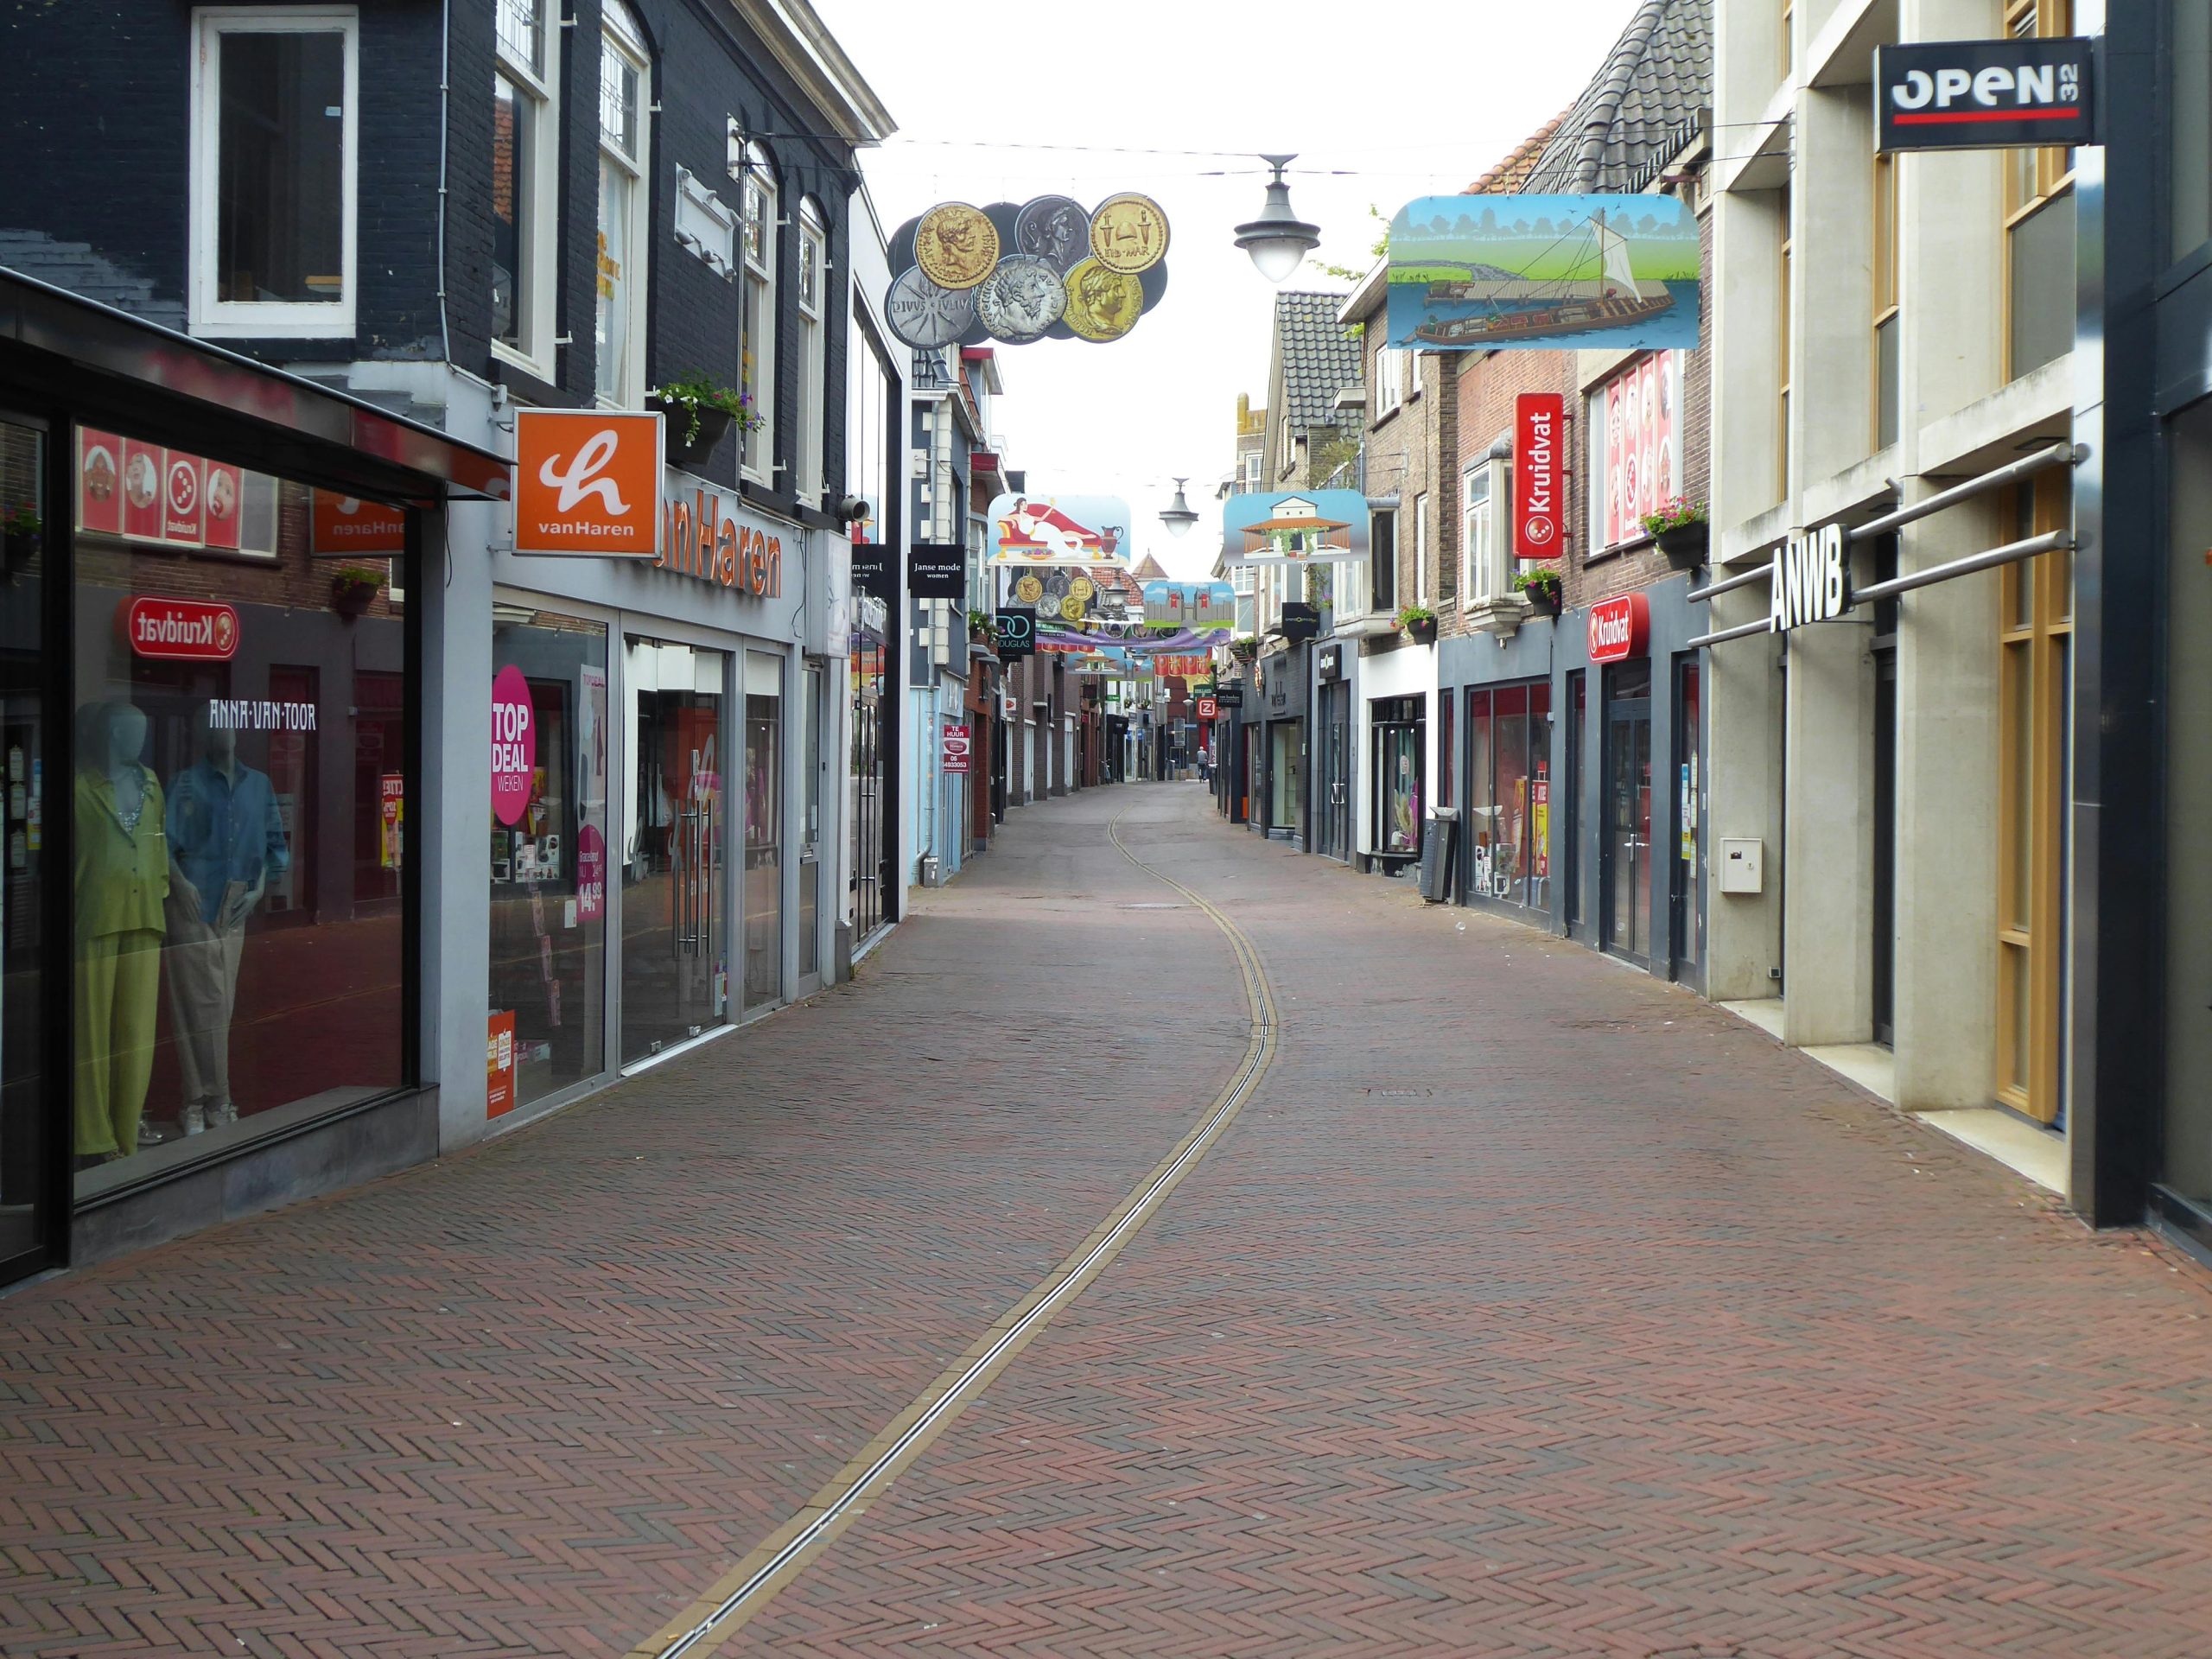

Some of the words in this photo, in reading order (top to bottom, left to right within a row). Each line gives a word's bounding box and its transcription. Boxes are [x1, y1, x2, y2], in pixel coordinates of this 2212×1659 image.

[1892, 65, 2054, 109] OPEN
[2060, 63, 2079, 102] 32
[1528, 412, 1551, 512] Kruidvat
[538, 521, 634, 536] vanHaren
[653, 488, 781, 598] nHaren
[914, 563, 936, 572] Janse
[938, 563, 961, 571] mode
[1770, 523, 1843, 634] ANWB
[997, 639, 1030, 648] OUGLAS
[1599, 609, 1630, 647] Kruidvat
[493, 702, 529, 742] TOP
[493, 743, 529, 772] DEAL
[498, 775, 524, 791] WEKEN
